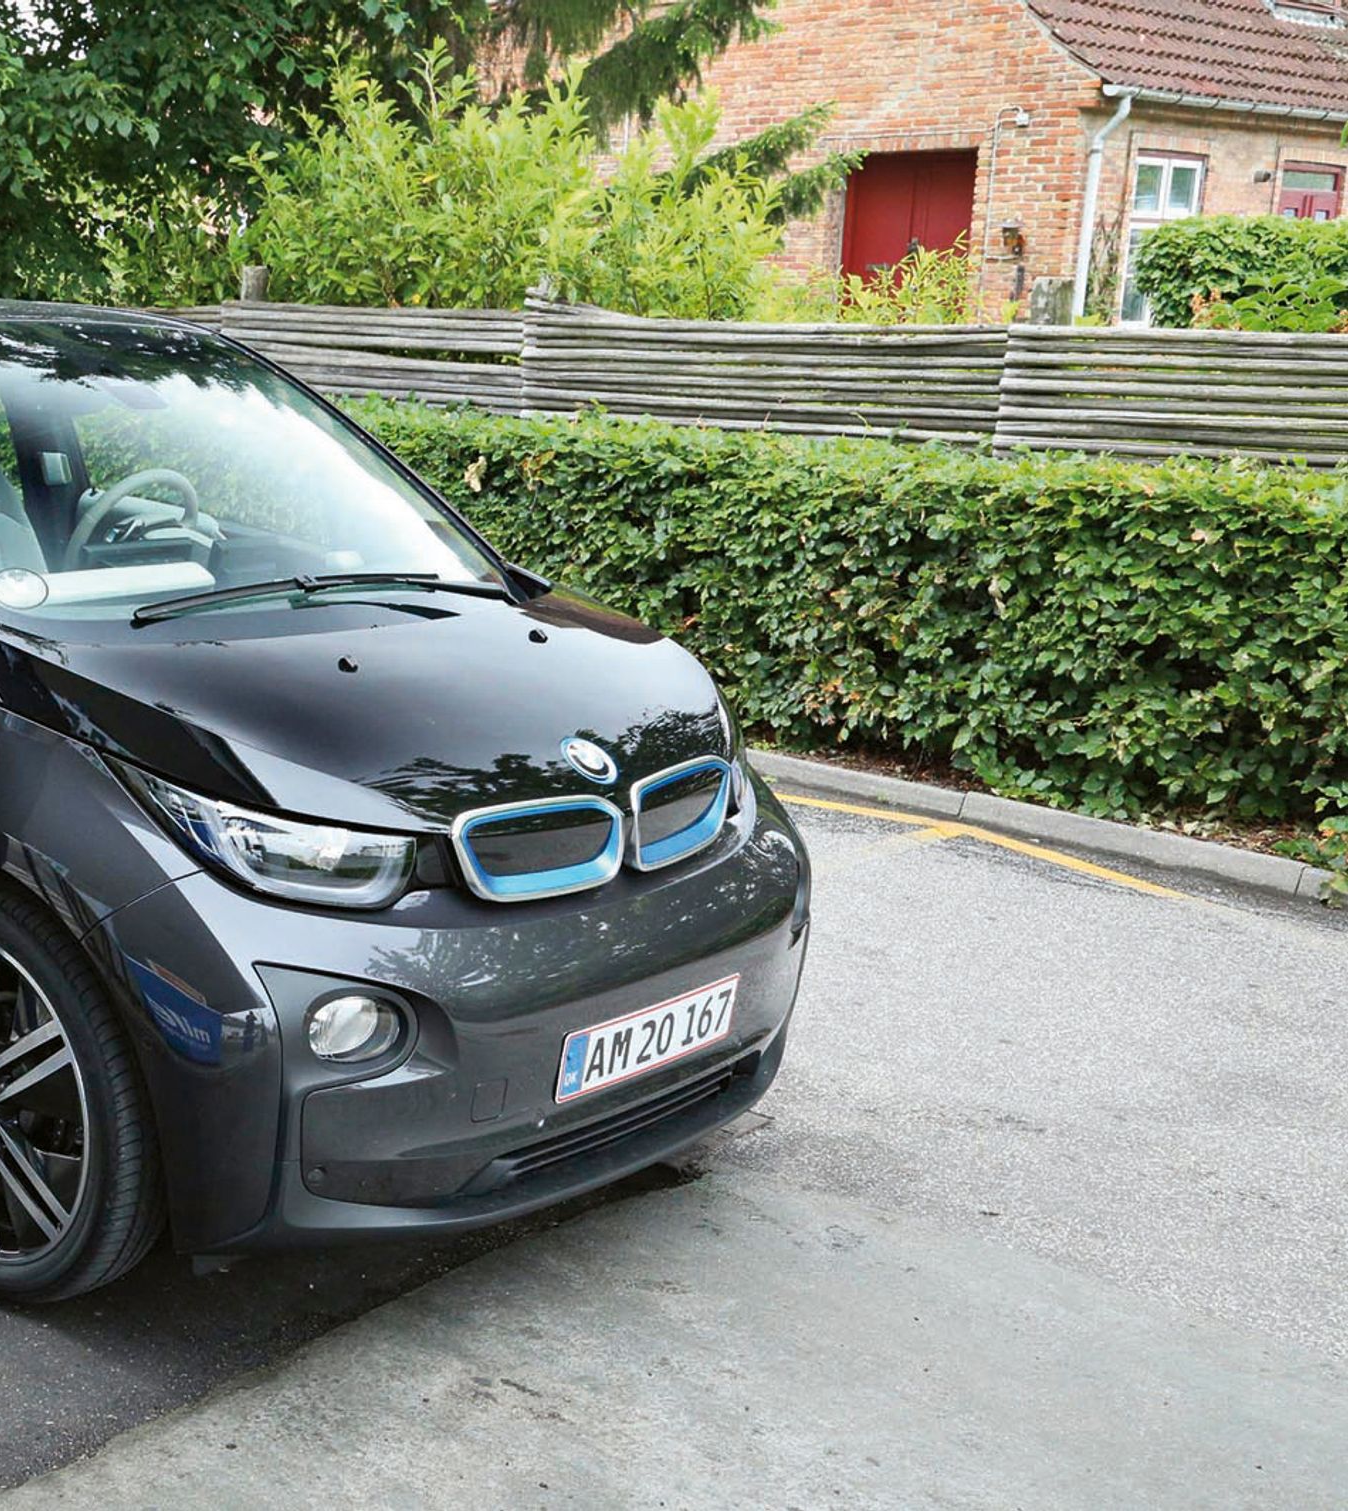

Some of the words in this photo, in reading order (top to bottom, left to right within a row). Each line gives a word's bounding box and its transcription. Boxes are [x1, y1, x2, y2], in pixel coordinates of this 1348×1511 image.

[585, 1027, 633, 1082] AM
[636, 1012, 675, 1064] 20
[681, 988, 732, 1047] 167
